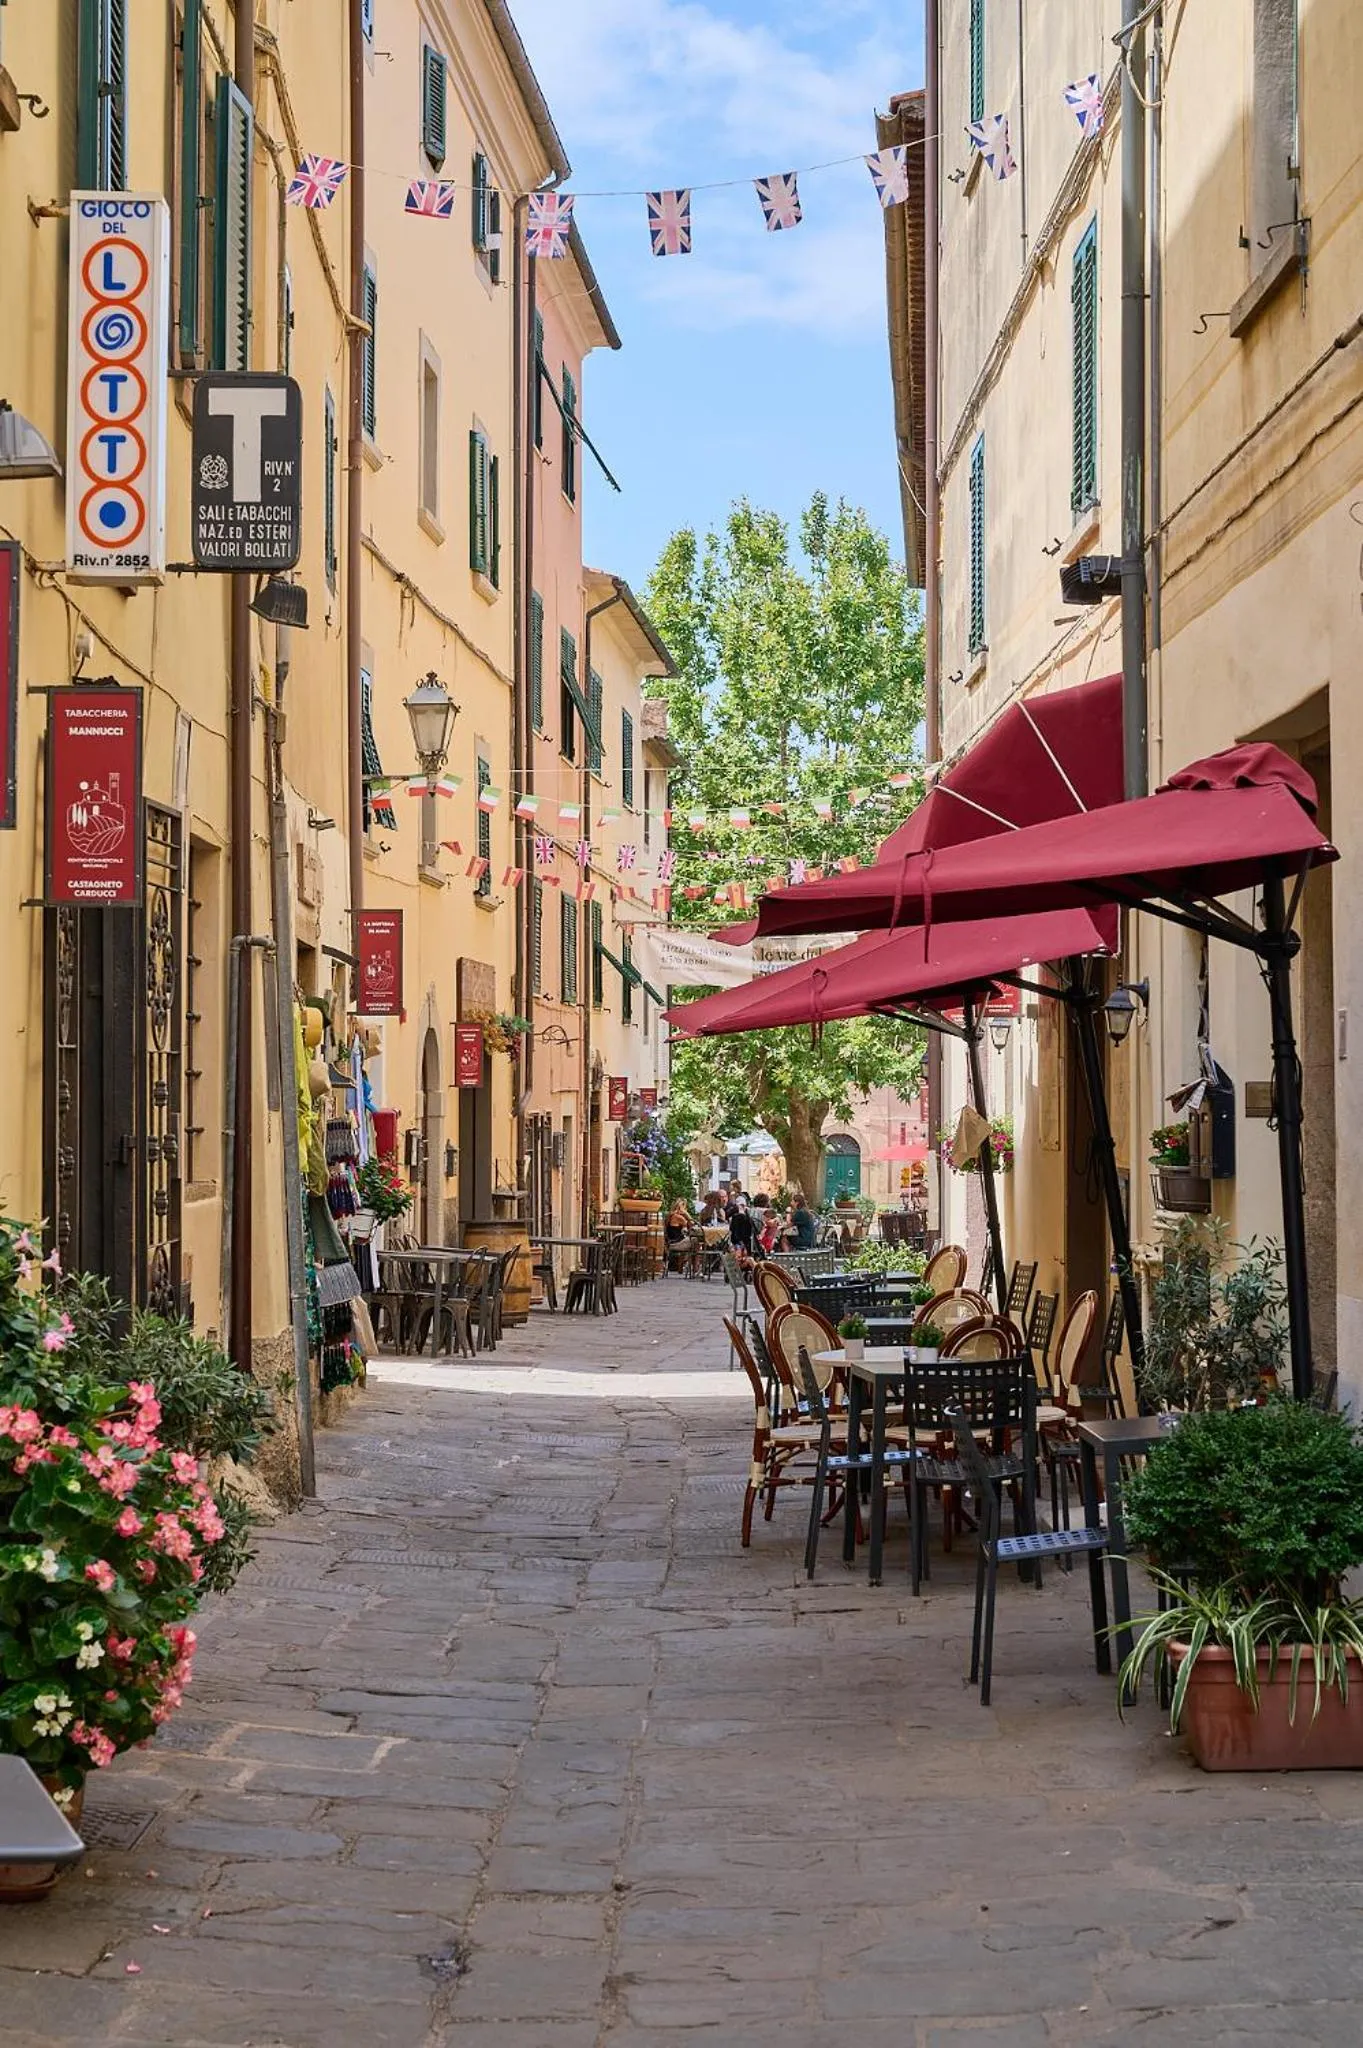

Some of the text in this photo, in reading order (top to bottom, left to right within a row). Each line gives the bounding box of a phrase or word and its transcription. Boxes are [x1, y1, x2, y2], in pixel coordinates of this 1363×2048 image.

[81, 201, 150, 218] GIOCO
[102, 222, 127, 234] DEL
[208, 387, 287, 502] T
[273, 478, 281, 492] 2
[199, 505, 225, 520] SALI
[235, 505, 292, 521] TABACCHI
[249, 524, 292, 540] ESTERI
[199, 542, 291, 558] VALORI BOLLATI
[115, 554, 150, 567] 2852
[64, 709, 128, 718] TABACCHERIA
[68, 727, 124, 736] MANNUCCI
[67, 880, 124, 889] CASTAGNETO
